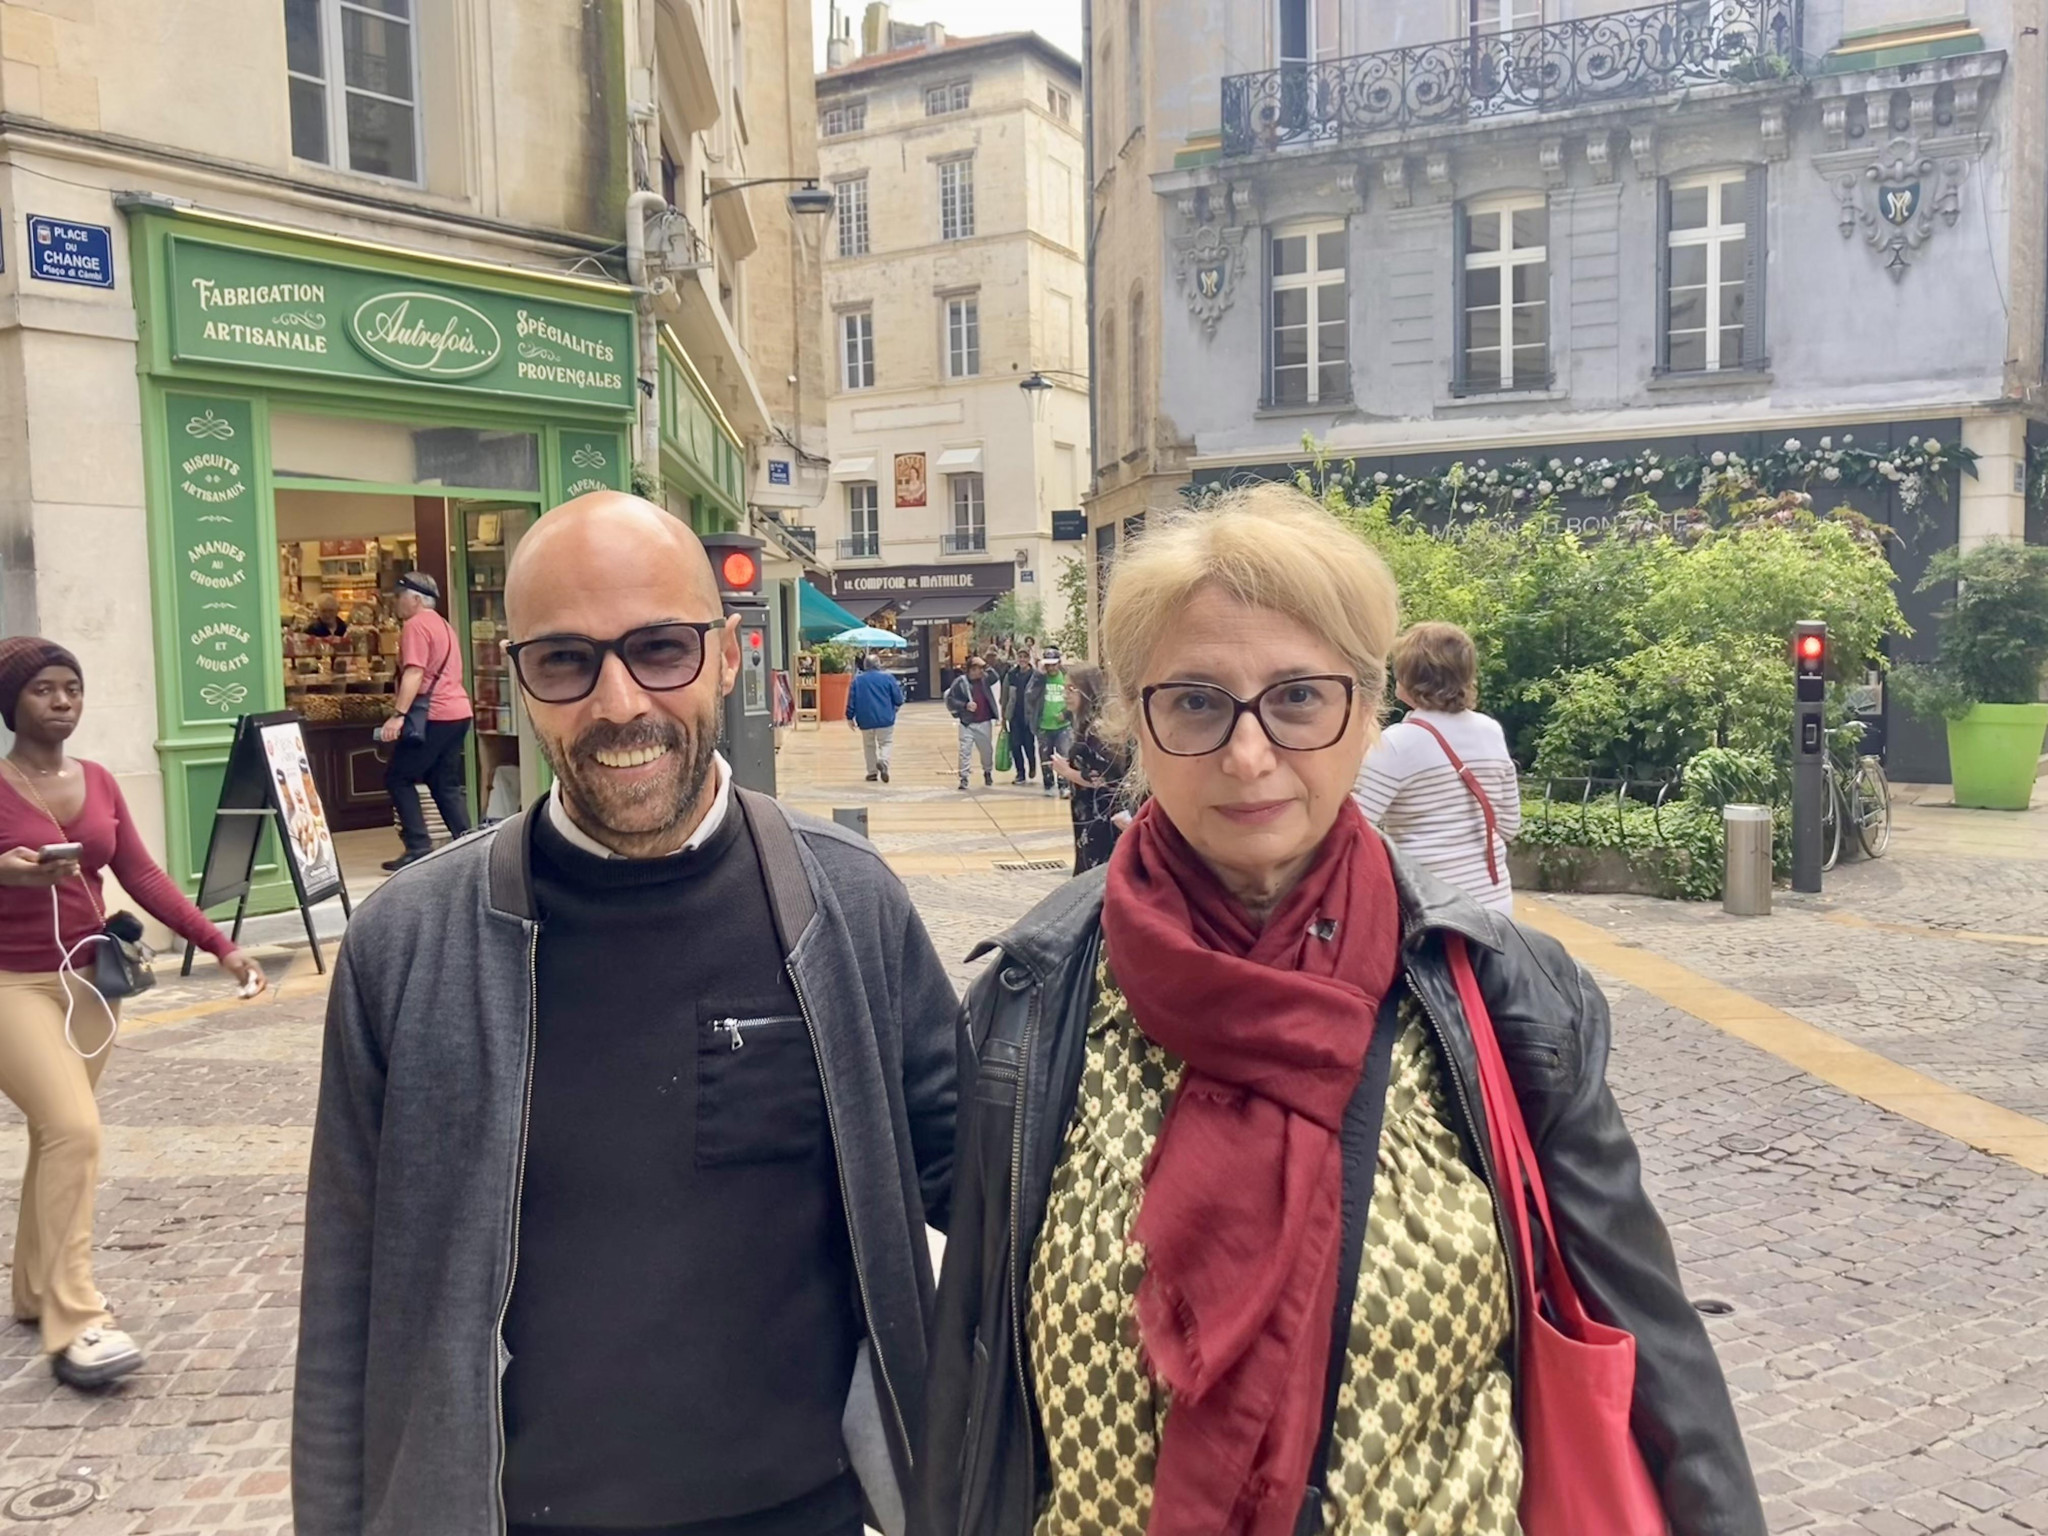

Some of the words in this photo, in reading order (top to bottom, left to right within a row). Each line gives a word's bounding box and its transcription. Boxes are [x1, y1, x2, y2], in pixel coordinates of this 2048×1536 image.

[54, 227, 88, 242] PLACE
[65, 242, 77, 252] DU
[44, 250, 100, 270] CHANGE
[203, 321, 327, 354] ARTISANALE
[518, 362, 622, 390] PROVENÇALES
[182, 453, 240, 475] BISCUITS
[181, 480, 246, 502] ARTISANAUX
[567, 478, 611, 496] TAPENAD
[188, 541, 246, 563] AMANDES
[211, 560, 223, 569] AU
[190, 569, 246, 588] CHOCOLAT
[844, 580, 853, 590] LE
[854, 576, 905, 590] COMPTOIR
[920, 574, 974, 588] MATHILDE
[191, 622, 250, 645] CARAMELS
[215, 642, 227, 651] ET
[196, 653, 249, 672] NOUGATS
